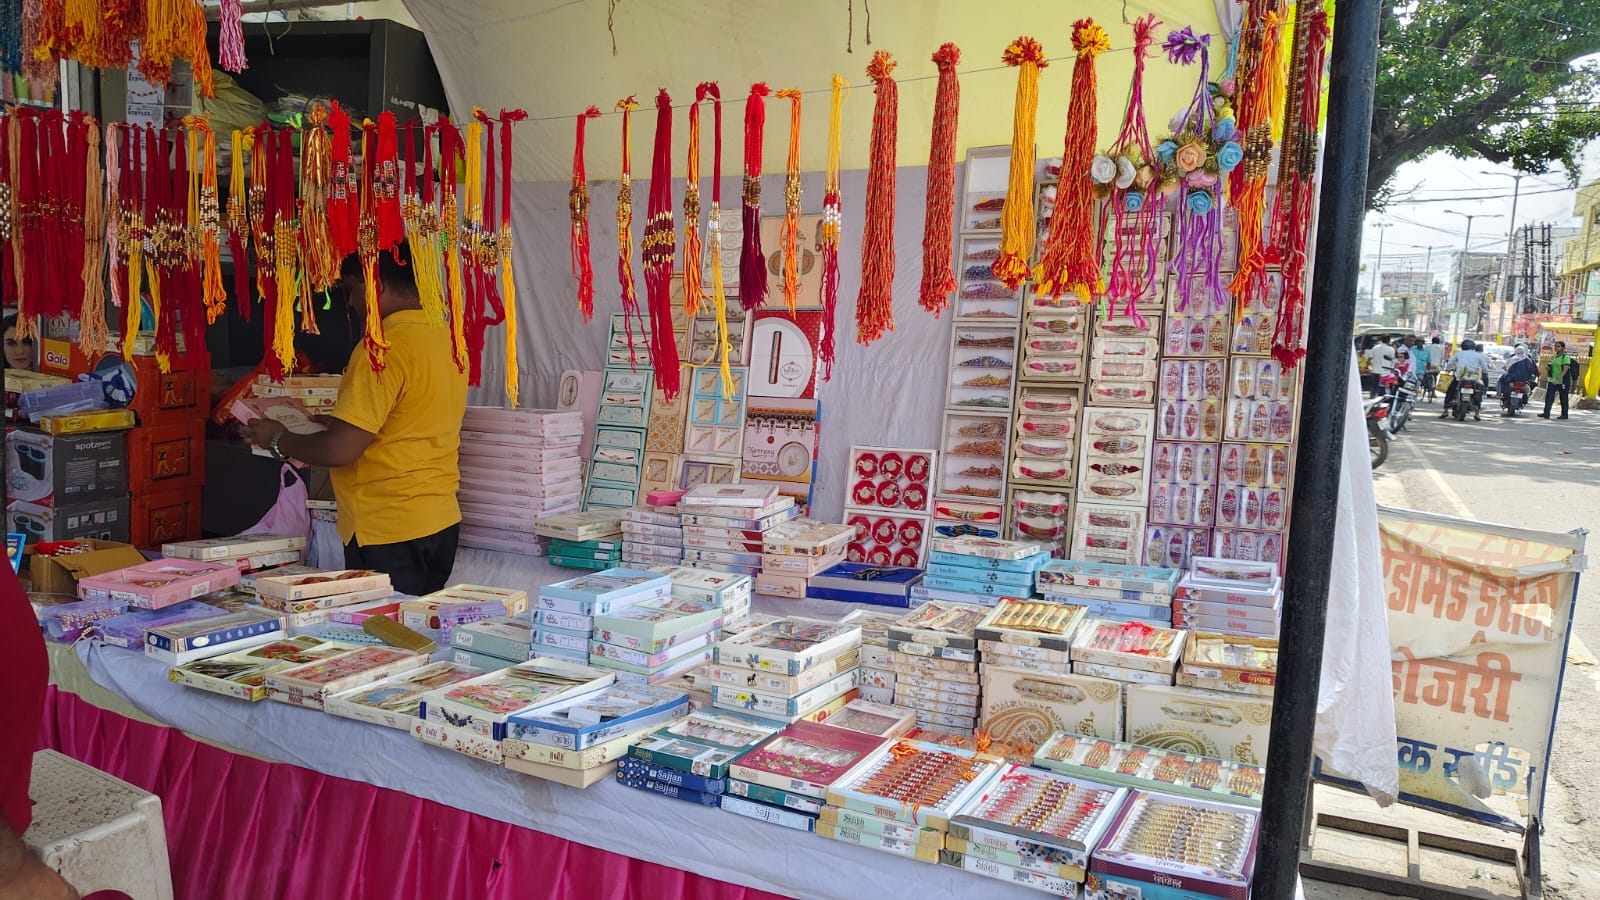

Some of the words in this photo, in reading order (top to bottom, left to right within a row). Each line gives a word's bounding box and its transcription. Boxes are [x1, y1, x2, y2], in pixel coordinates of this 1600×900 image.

[46, 351, 69, 366] Gala
[657, 769, 682, 784] Sajjan
[654, 781, 679, 794] Sajjan
[755, 806, 780, 820] Sajjan
